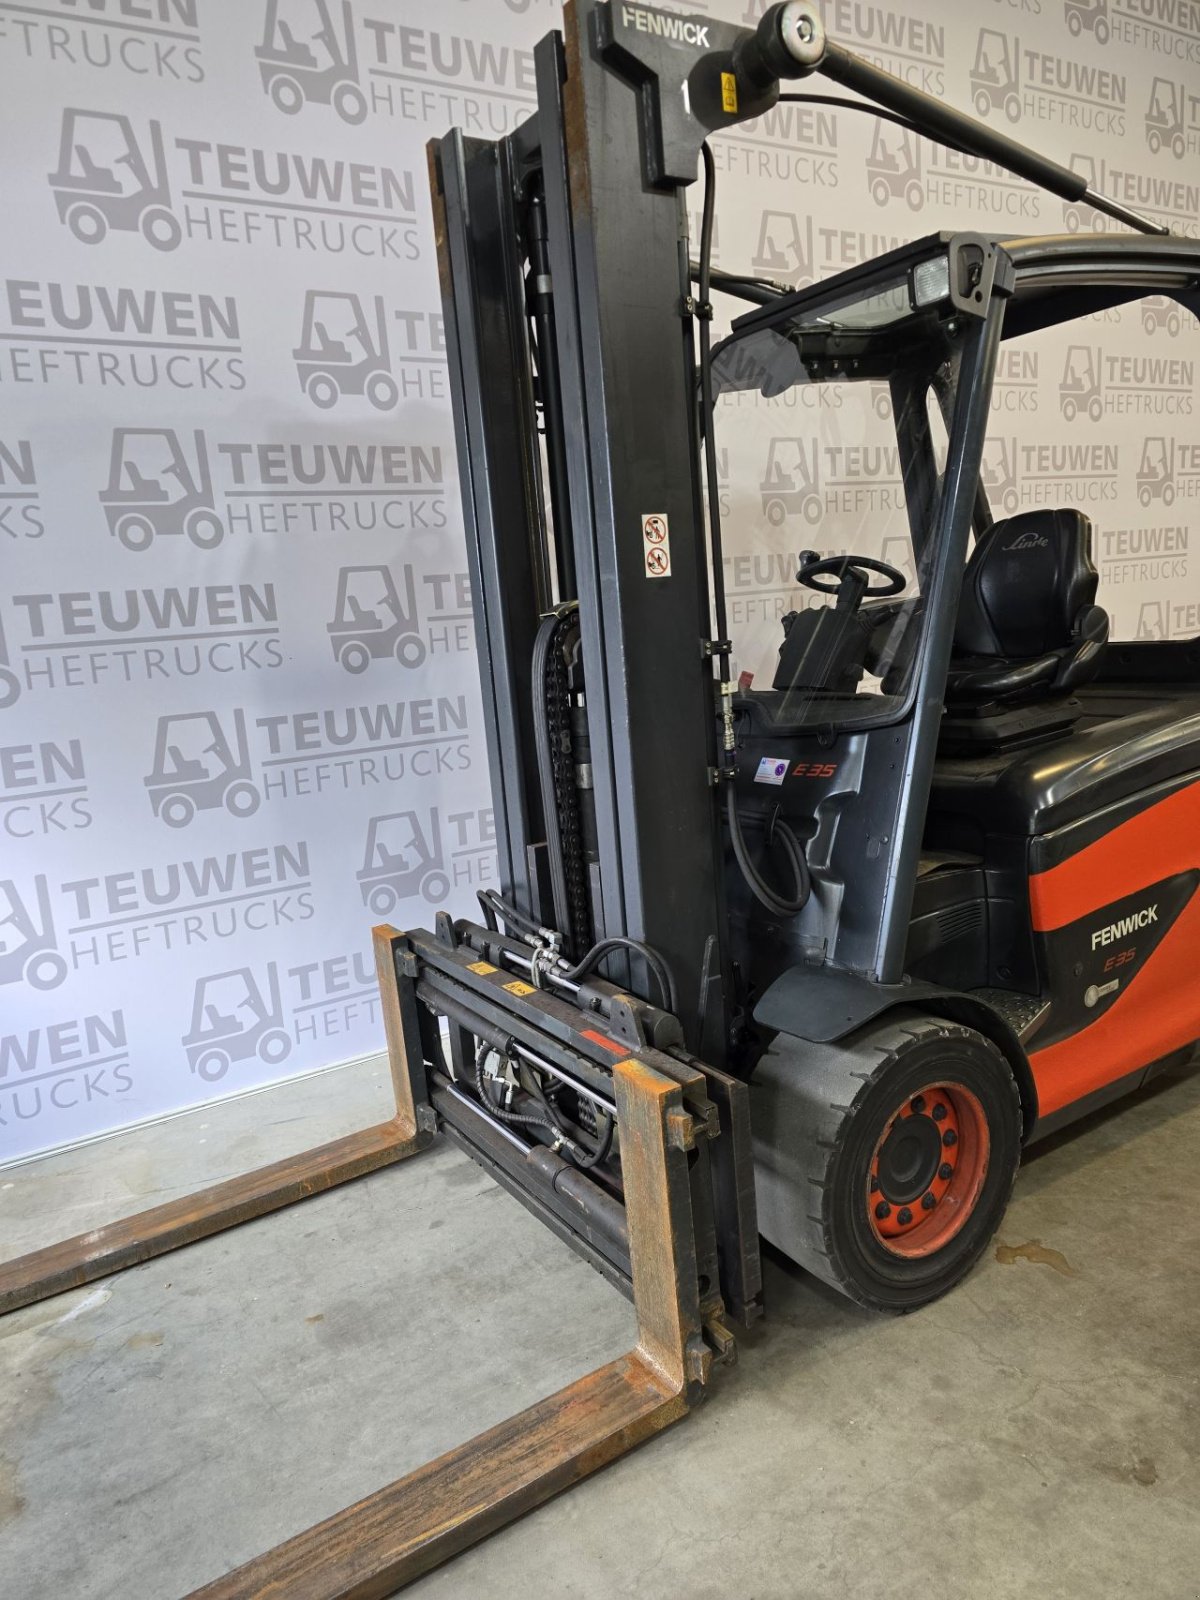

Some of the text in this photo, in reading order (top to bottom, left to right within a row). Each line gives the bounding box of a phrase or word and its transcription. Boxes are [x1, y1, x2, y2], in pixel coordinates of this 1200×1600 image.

[622, 6, 710, 48] FENWICK
[1024, 50, 1126, 104] TEUWEN
[1023, 93, 1126, 137] HEFTRUCKS
[175, 137, 416, 212] TEUWEN
[1109, 169, 1200, 212] TEUWEN
[926, 179, 1040, 218] HEFTRUCKS
[184, 205, 420, 261] HEFTRUCKS
[0, 348, 247, 391] EFTRUCKS
[1106, 356, 1194, 386] TEUWEN
[1105, 394, 1193, 415] HEFTRUCKS
[218, 443, 444, 485] TEUWEN
[1022, 445, 1118, 472] TEUWEN
[1021, 481, 1118, 504] HEFTRUCKS
[227, 500, 448, 534] HEFTRUCKS
[1102, 526, 1189, 556] TEUWEN
[1101, 559, 1188, 585] HEFTRUCKS
[12, 583, 279, 637] TEUWEN
[23, 639, 283, 690] HEFTRUCKS
[255, 695, 468, 760] TEUWEN
[263, 744, 471, 801] HEFTRUCKS
[61, 841, 311, 920] TEUWEN
[71, 892, 315, 970] HEFTRUCKS
[1091, 903, 1158, 951] FENWICK
